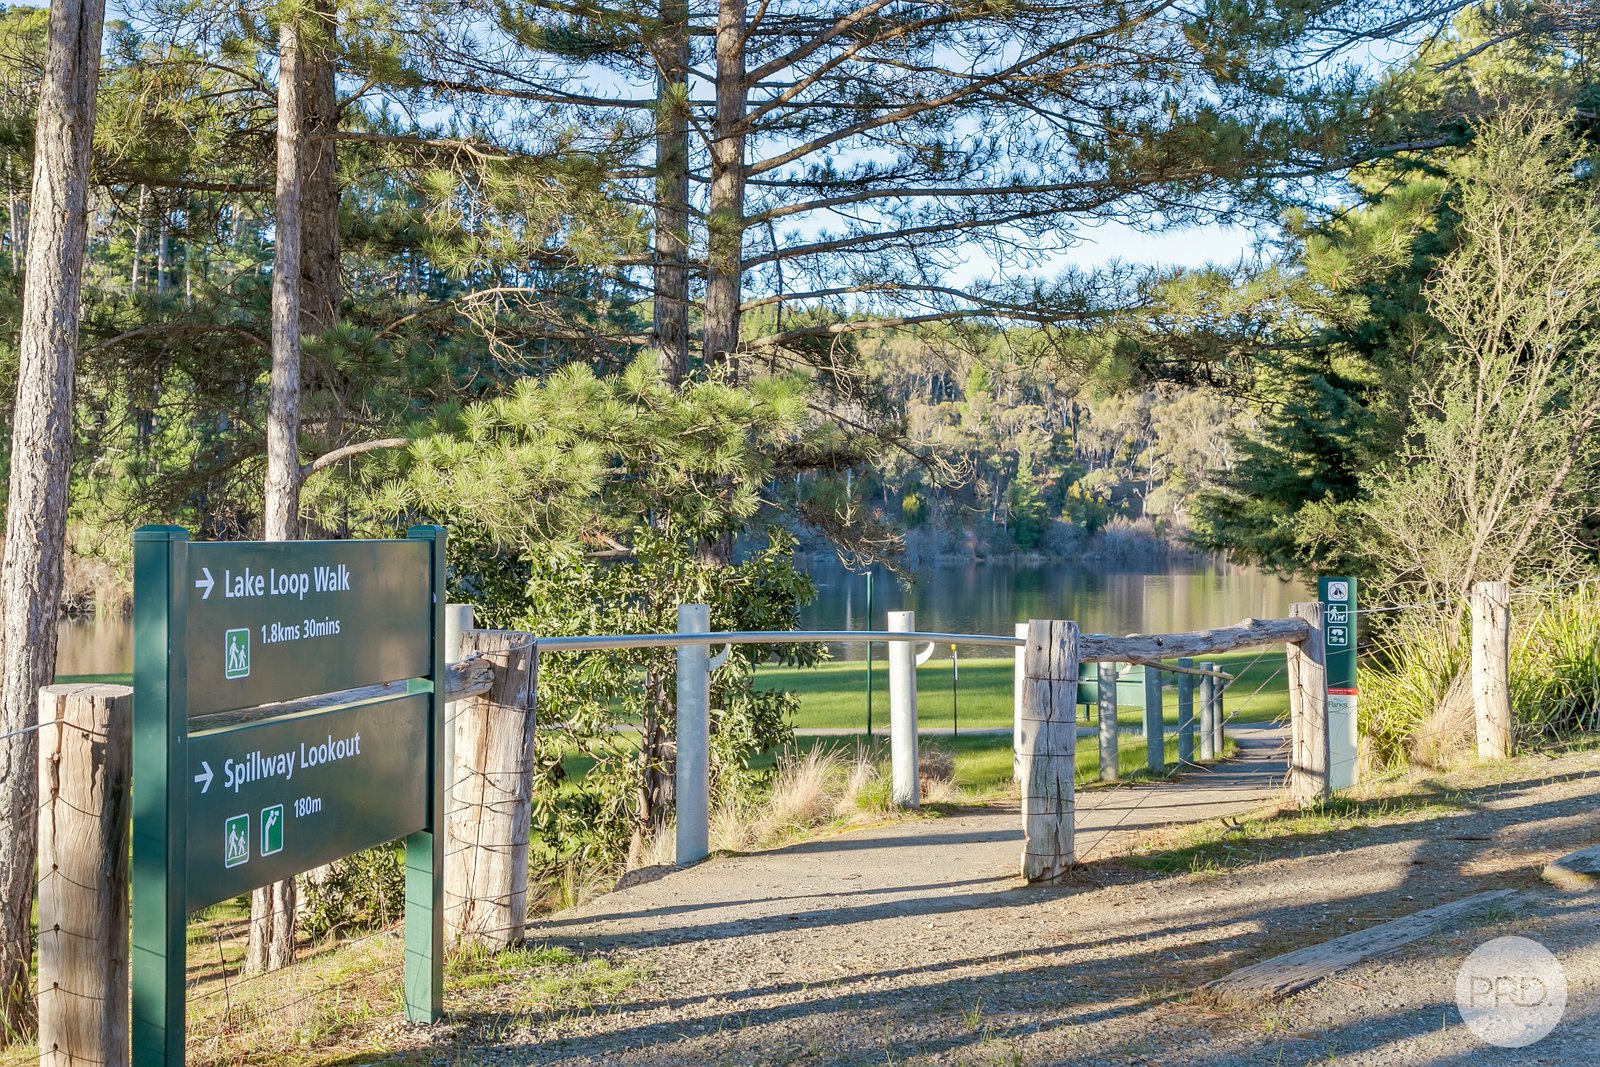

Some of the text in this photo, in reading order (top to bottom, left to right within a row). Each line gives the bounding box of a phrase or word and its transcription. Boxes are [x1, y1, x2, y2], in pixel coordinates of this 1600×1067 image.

[225, 564, 350, 600] Lake Loop Walk
[261, 616, 340, 643] 1.8kms 30mins
[224, 732, 361, 793] Spillway Lookout
[293, 796, 322, 818] 180m
